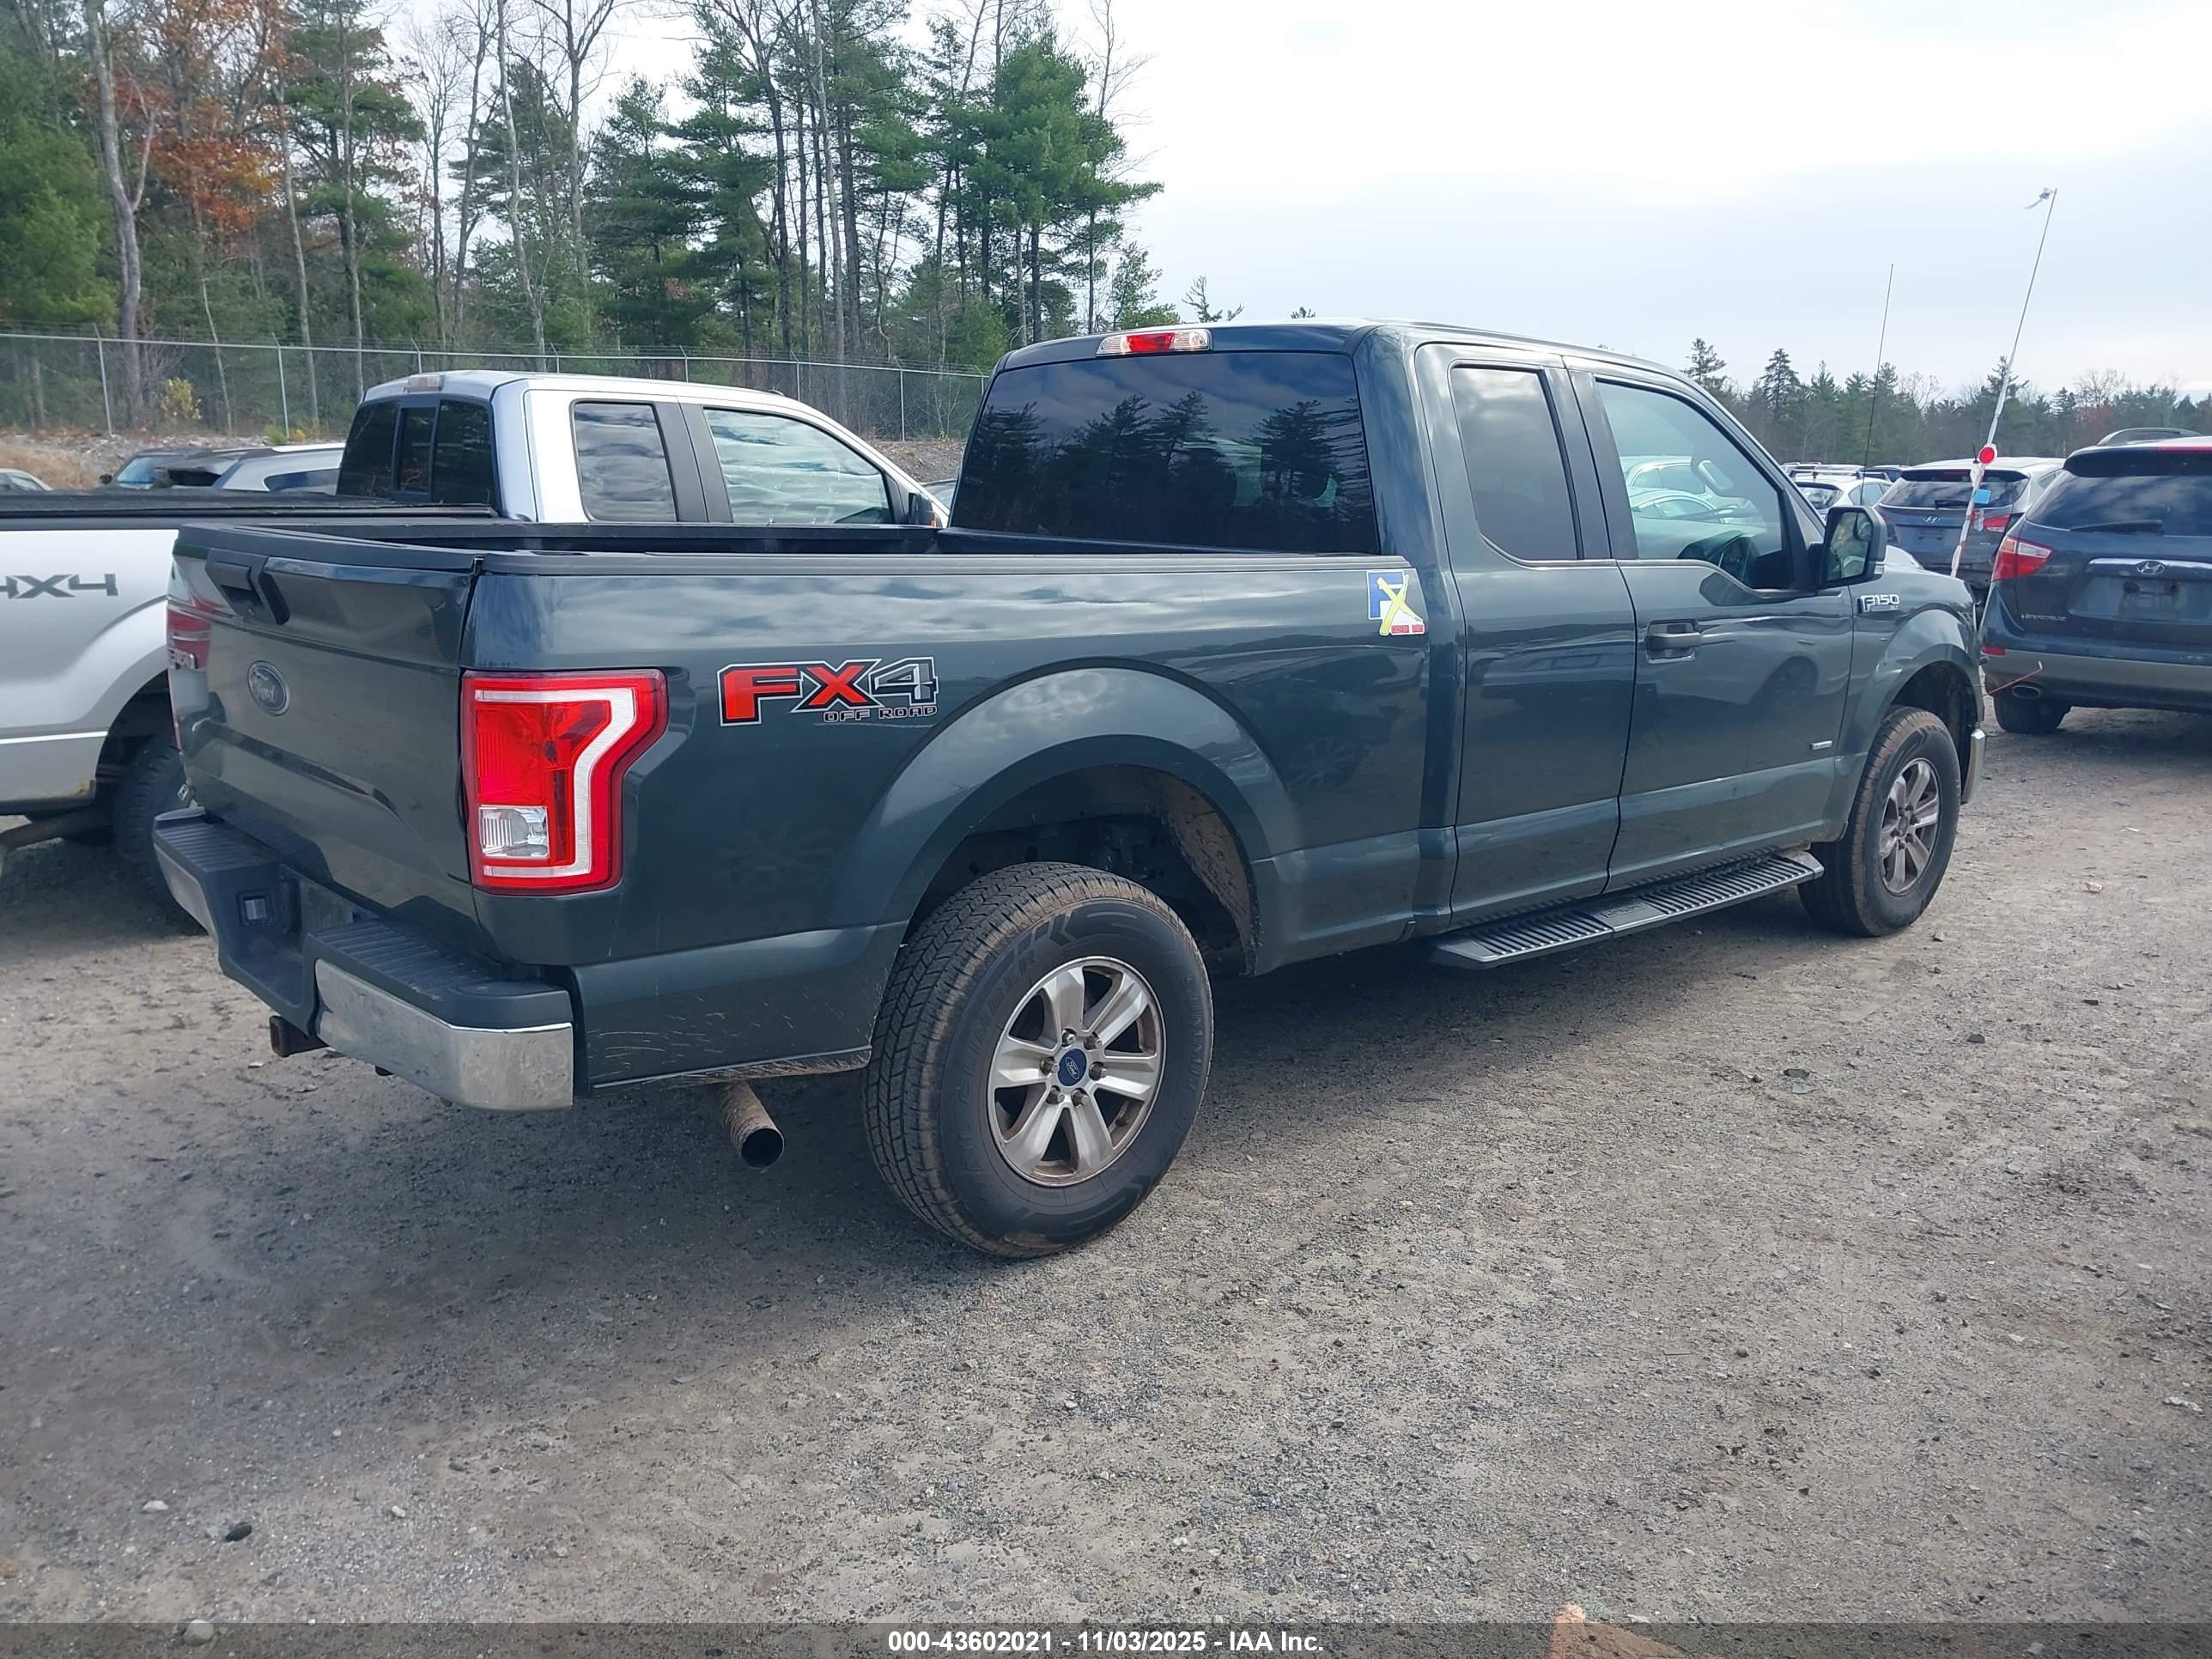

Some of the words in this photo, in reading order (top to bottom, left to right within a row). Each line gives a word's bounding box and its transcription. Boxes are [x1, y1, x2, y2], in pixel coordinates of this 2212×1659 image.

[1860, 593, 1900, 612] F150
[717, 656, 939, 726] FX4
[823, 708, 871, 722] OFF
[878, 705, 938, 720] ROAD
